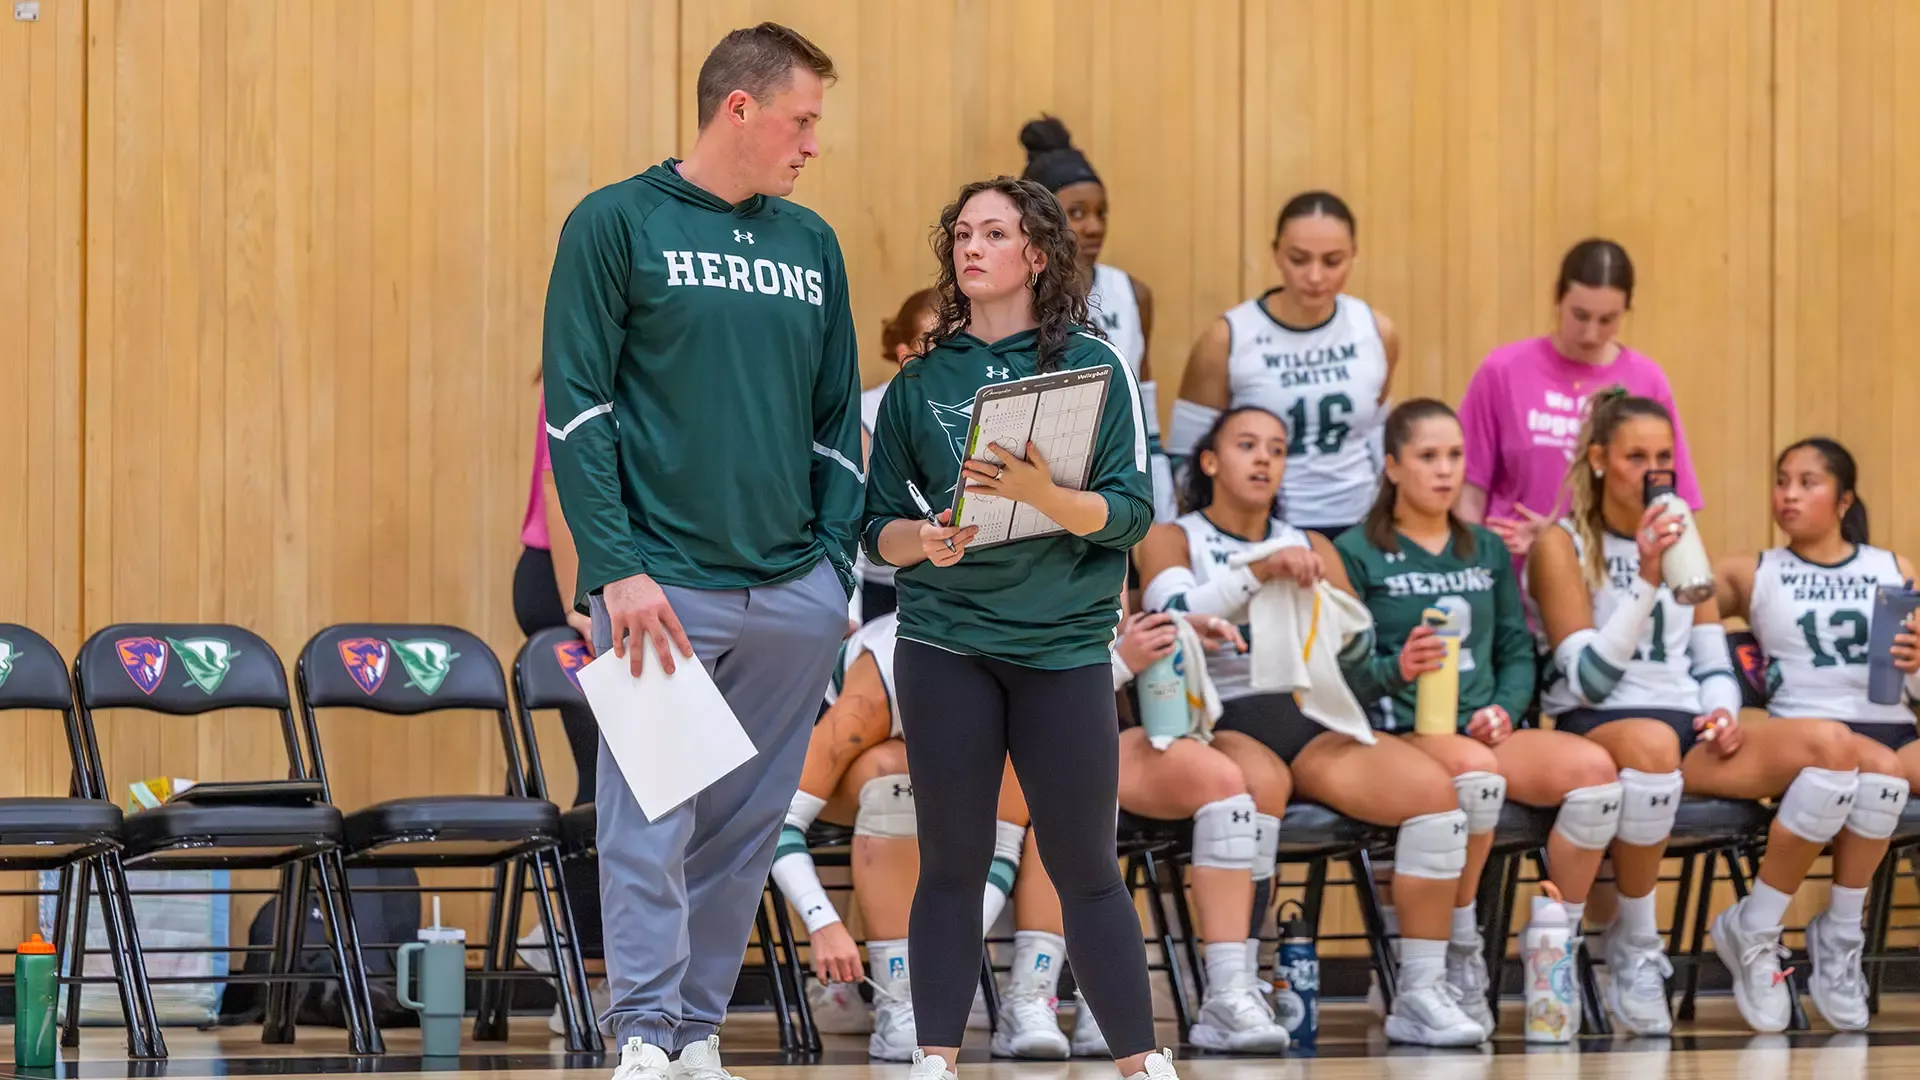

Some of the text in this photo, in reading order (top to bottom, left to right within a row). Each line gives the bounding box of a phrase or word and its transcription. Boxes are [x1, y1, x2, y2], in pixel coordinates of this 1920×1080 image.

[662, 250, 823, 306] HERONS
[1262, 343, 1359, 370] WILLIAM
[1280, 364, 1350, 389] SMITH
[1286, 391, 1353, 456] 16
[1780, 571, 1878, 589] WILLIAM
[1793, 586, 1869, 601] SMITH
[1796, 608, 1868, 668] 12
